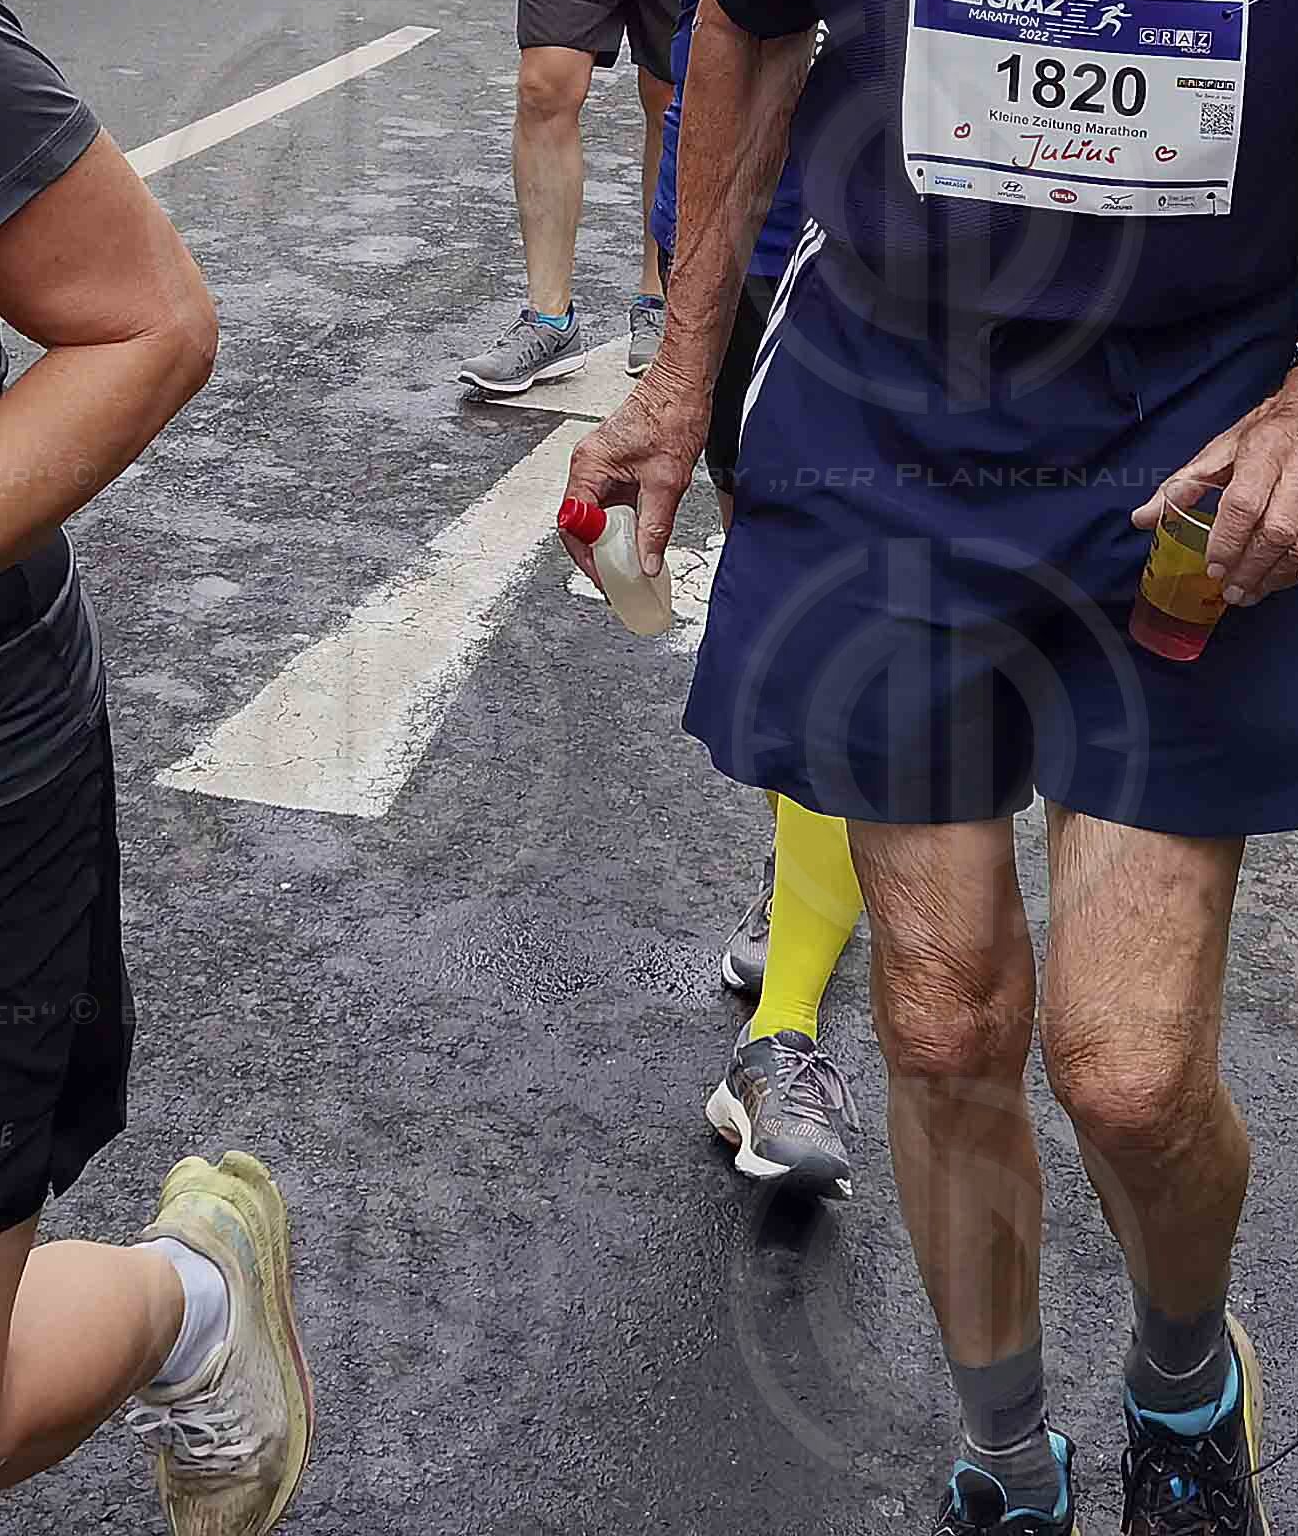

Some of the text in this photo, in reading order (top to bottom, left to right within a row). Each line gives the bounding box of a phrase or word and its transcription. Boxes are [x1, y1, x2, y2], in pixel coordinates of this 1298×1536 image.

[968, 7, 1040, 27] MARATHON
[1019, 28, 1049, 42] 2022
[1140, 29, 1210, 47] GRAZ
[997, 53, 1147, 117] 1820
[989, 109, 1148, 139] Kleine Zeitung Marathon
